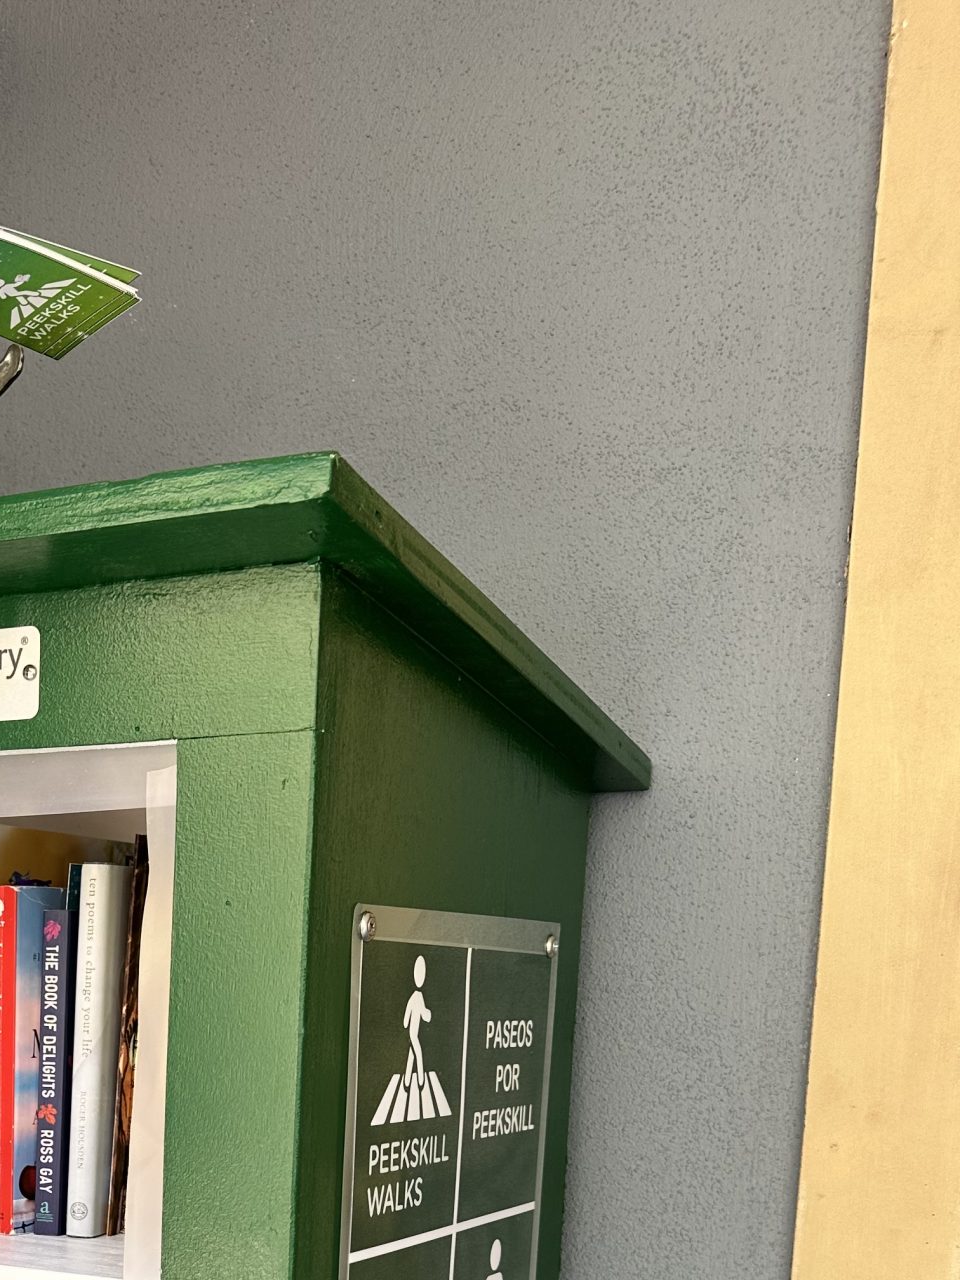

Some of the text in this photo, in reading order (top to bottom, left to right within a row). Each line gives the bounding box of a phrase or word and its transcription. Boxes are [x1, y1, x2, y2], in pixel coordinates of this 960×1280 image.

[17, 283, 92, 336] PEEKSKILL
[29, 304, 81, 340] WALKS
[85, 902, 96, 941] poems
[86, 947, 93, 956] to
[82, 960, 96, 1002] change
[41, 945, 59, 1098] THE BOOK OF DELIGHTS
[81, 1007, 92, 1035] your
[485, 1019, 533, 1049] PASEOS
[82, 1039, 92, 1058] life
[495, 1063, 520, 1093] POR
[472, 1103, 535, 1140] PEEKSKILL
[40, 1129, 54, 1164] ROSS
[368, 1133, 449, 1176] PEEKSKILL
[39, 1168, 53, 1194] GAY
[367, 1176, 423, 1218] WALKS
